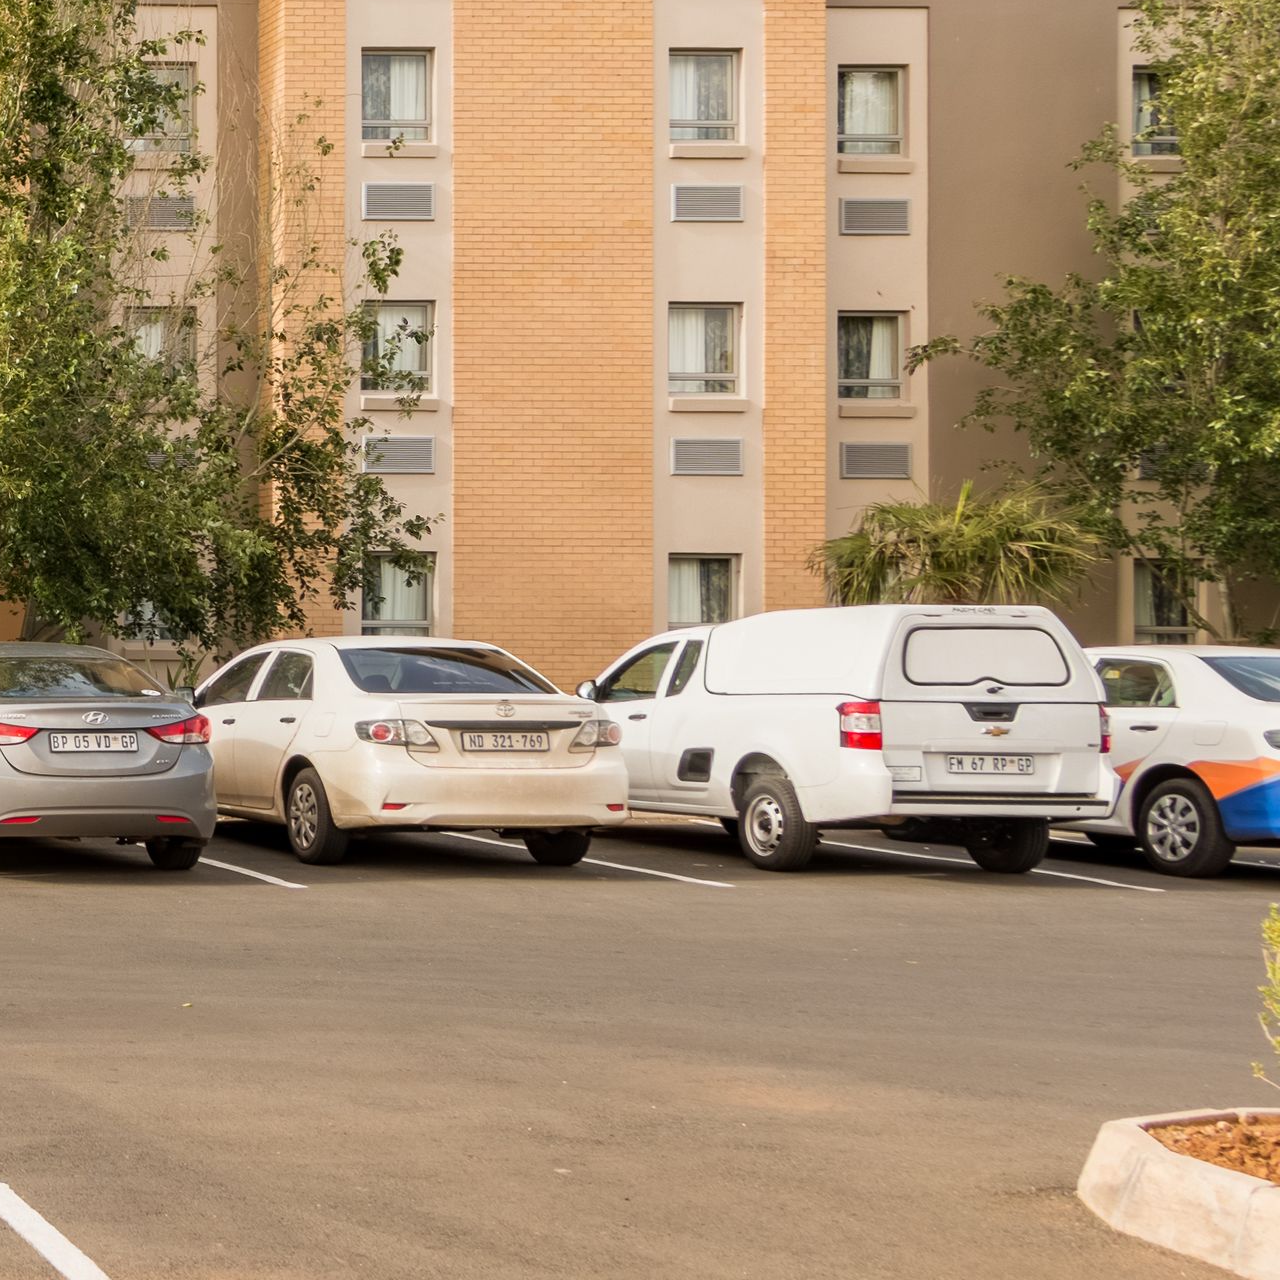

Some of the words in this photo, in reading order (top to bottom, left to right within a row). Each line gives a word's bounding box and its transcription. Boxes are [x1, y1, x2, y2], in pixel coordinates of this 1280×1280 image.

[53, 734, 68, 749] BP
[74, 734, 90, 749] 05
[95, 734, 111, 749] VD
[121, 735, 136, 749] GP
[469, 734, 484, 748] ND
[492, 734, 543, 748] 321-769
[949, 757, 963, 771] FM
[971, 757, 985, 771] 67
[993, 757, 1007, 772] RP
[1017, 758, 1032, 772] GP
